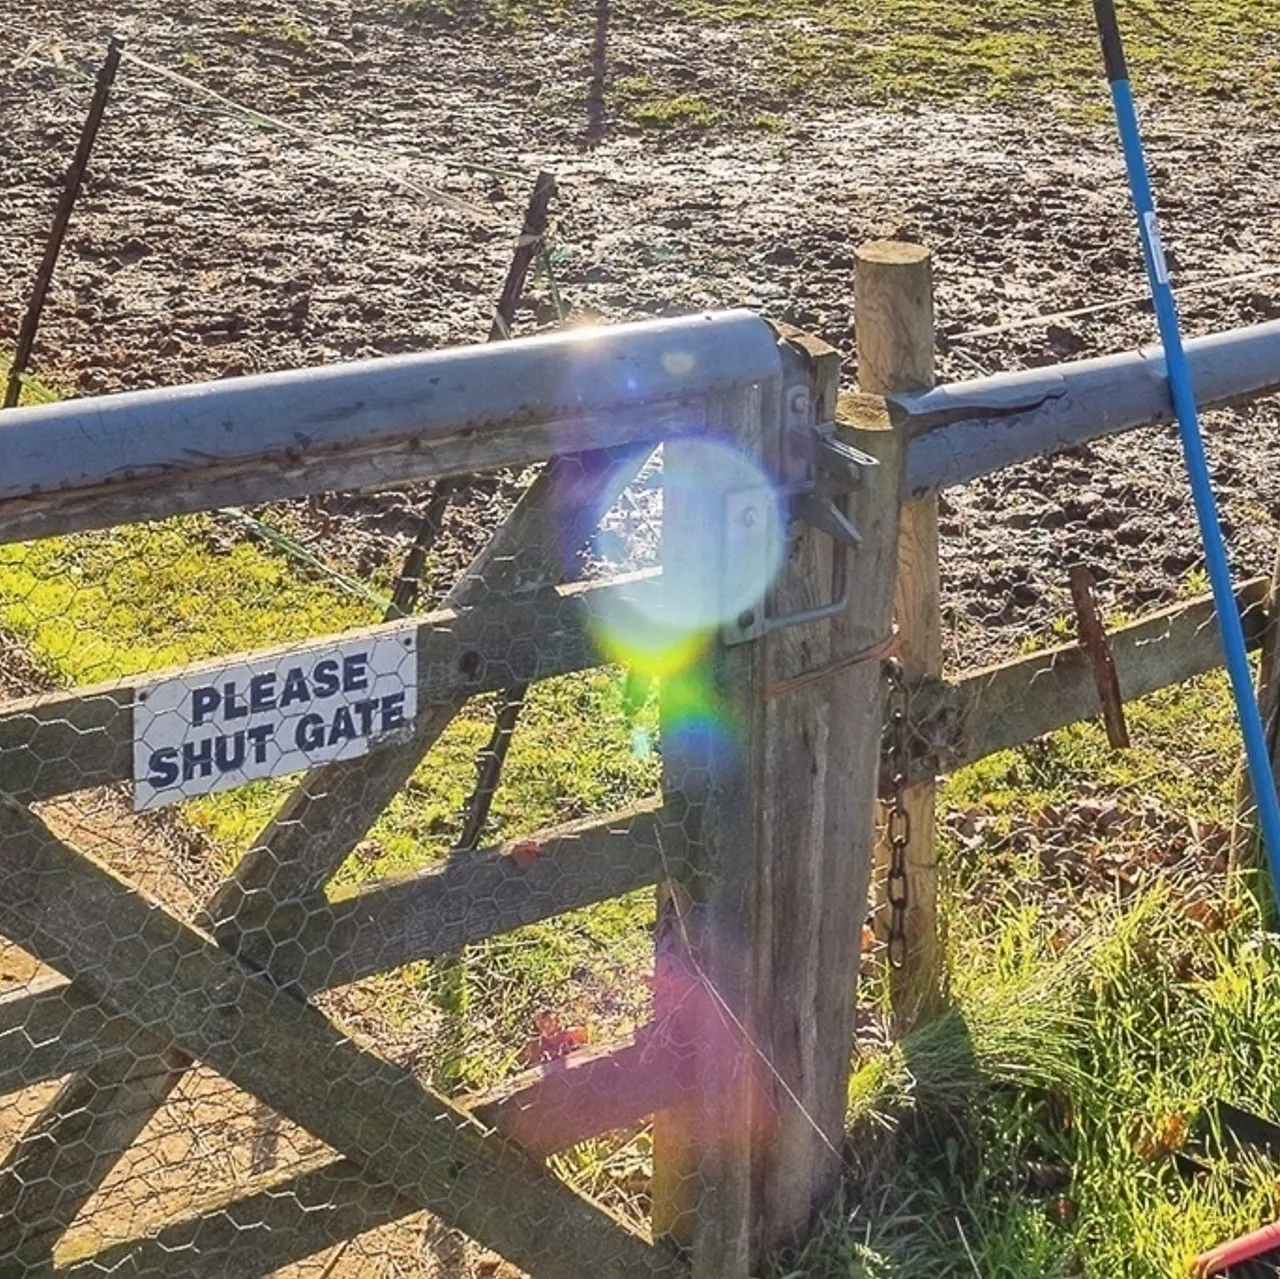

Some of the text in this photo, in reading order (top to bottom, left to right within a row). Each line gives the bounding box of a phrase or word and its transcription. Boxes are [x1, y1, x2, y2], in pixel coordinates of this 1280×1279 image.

[192, 652, 368, 727] PLEASE
[148, 692, 405, 788] SHUT GATE
